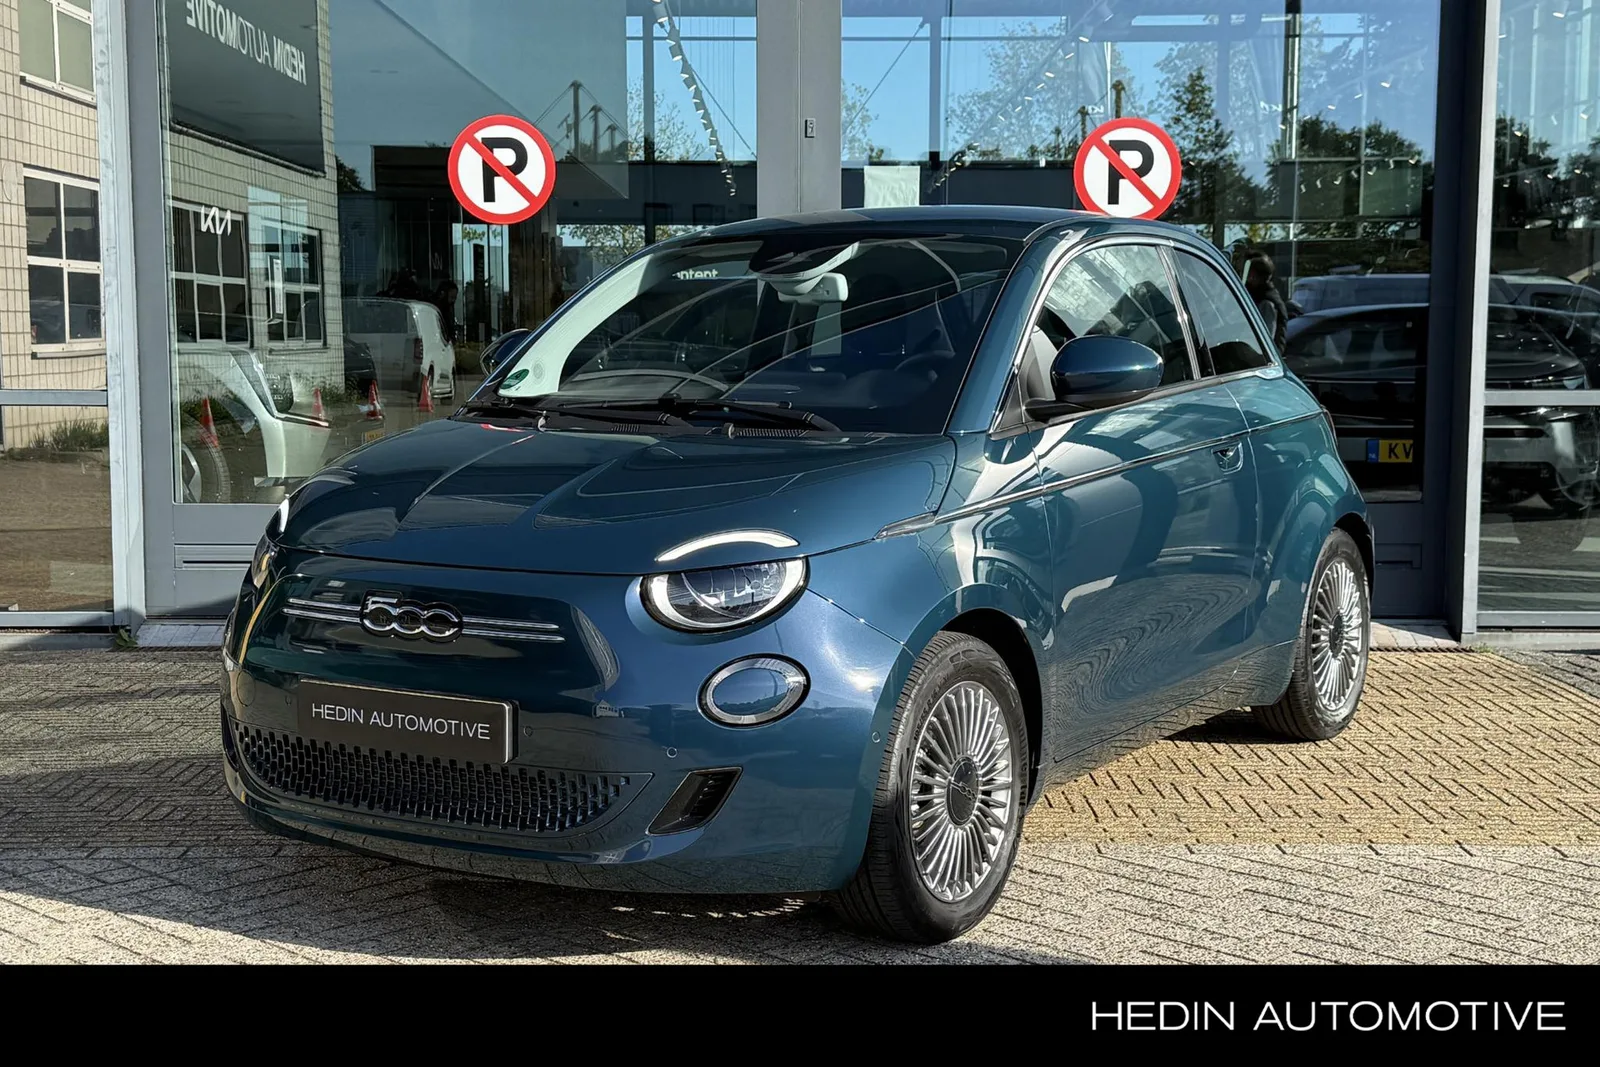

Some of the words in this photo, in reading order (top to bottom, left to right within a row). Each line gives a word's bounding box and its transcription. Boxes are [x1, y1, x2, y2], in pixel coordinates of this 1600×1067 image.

[481, 137, 528, 203] P
[1107, 140, 1154, 205] P
[1388, 442, 1414, 460] KV
[362, 593, 461, 640] 500
[311, 702, 364, 725] HEDIN
[369, 710, 491, 740] AUTOMOTIVE
